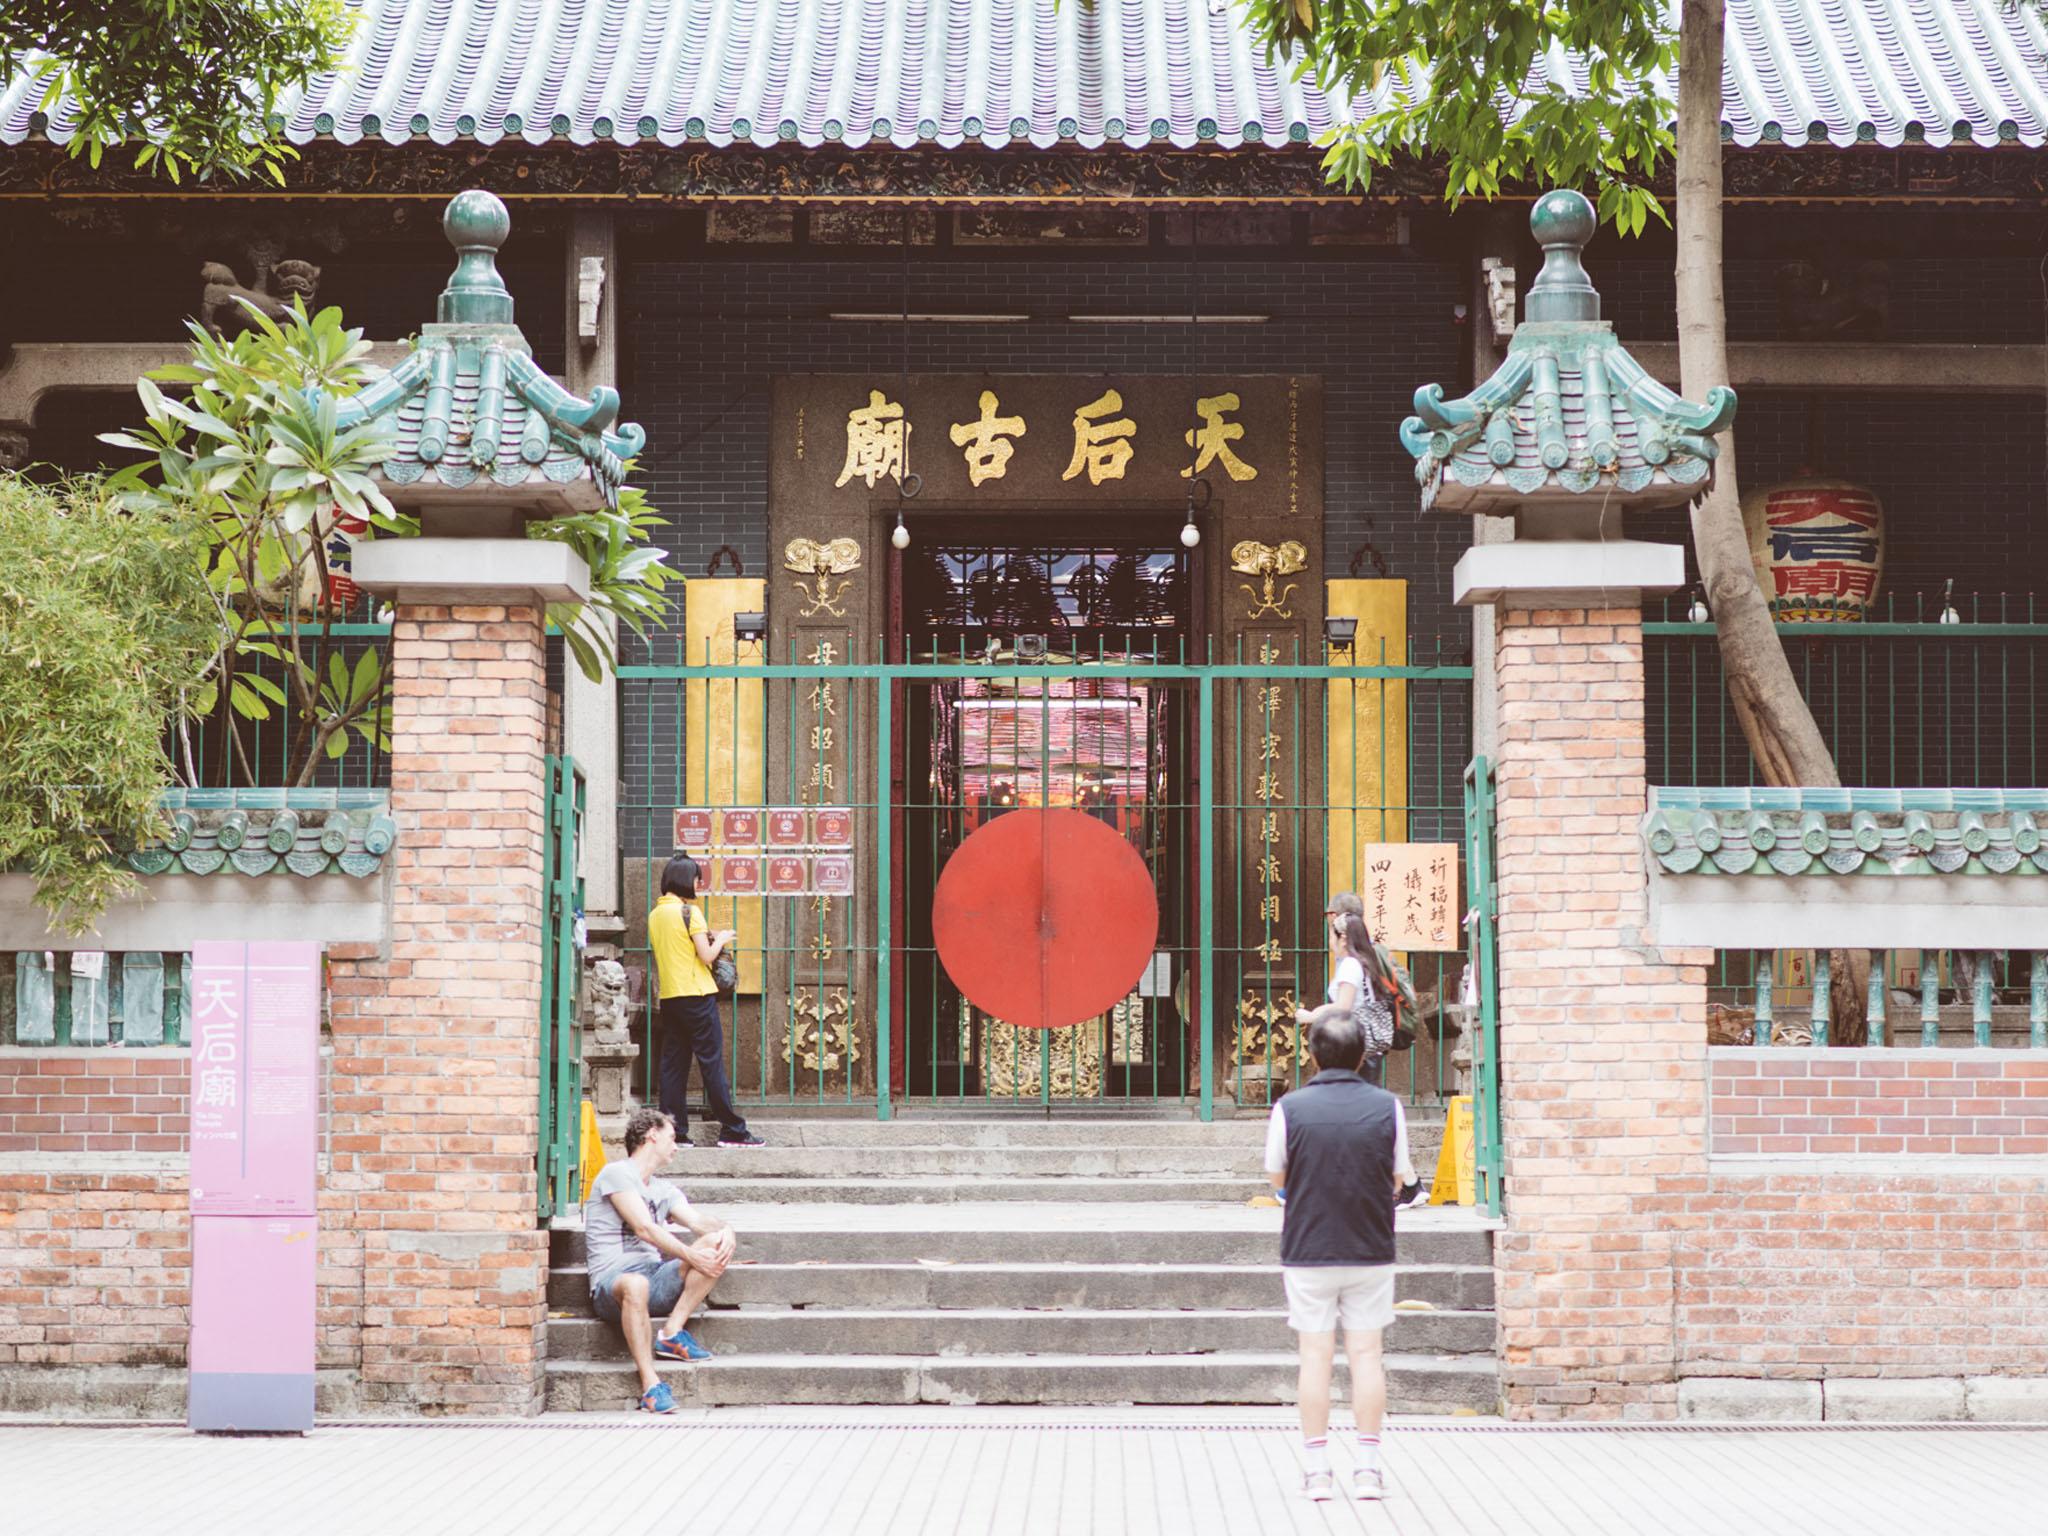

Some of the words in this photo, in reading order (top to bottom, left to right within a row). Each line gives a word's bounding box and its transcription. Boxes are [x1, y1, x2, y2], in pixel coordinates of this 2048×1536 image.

[835, 389, 1258, 488] 天后古廟
[196, 978, 239, 1108] 天后廟
